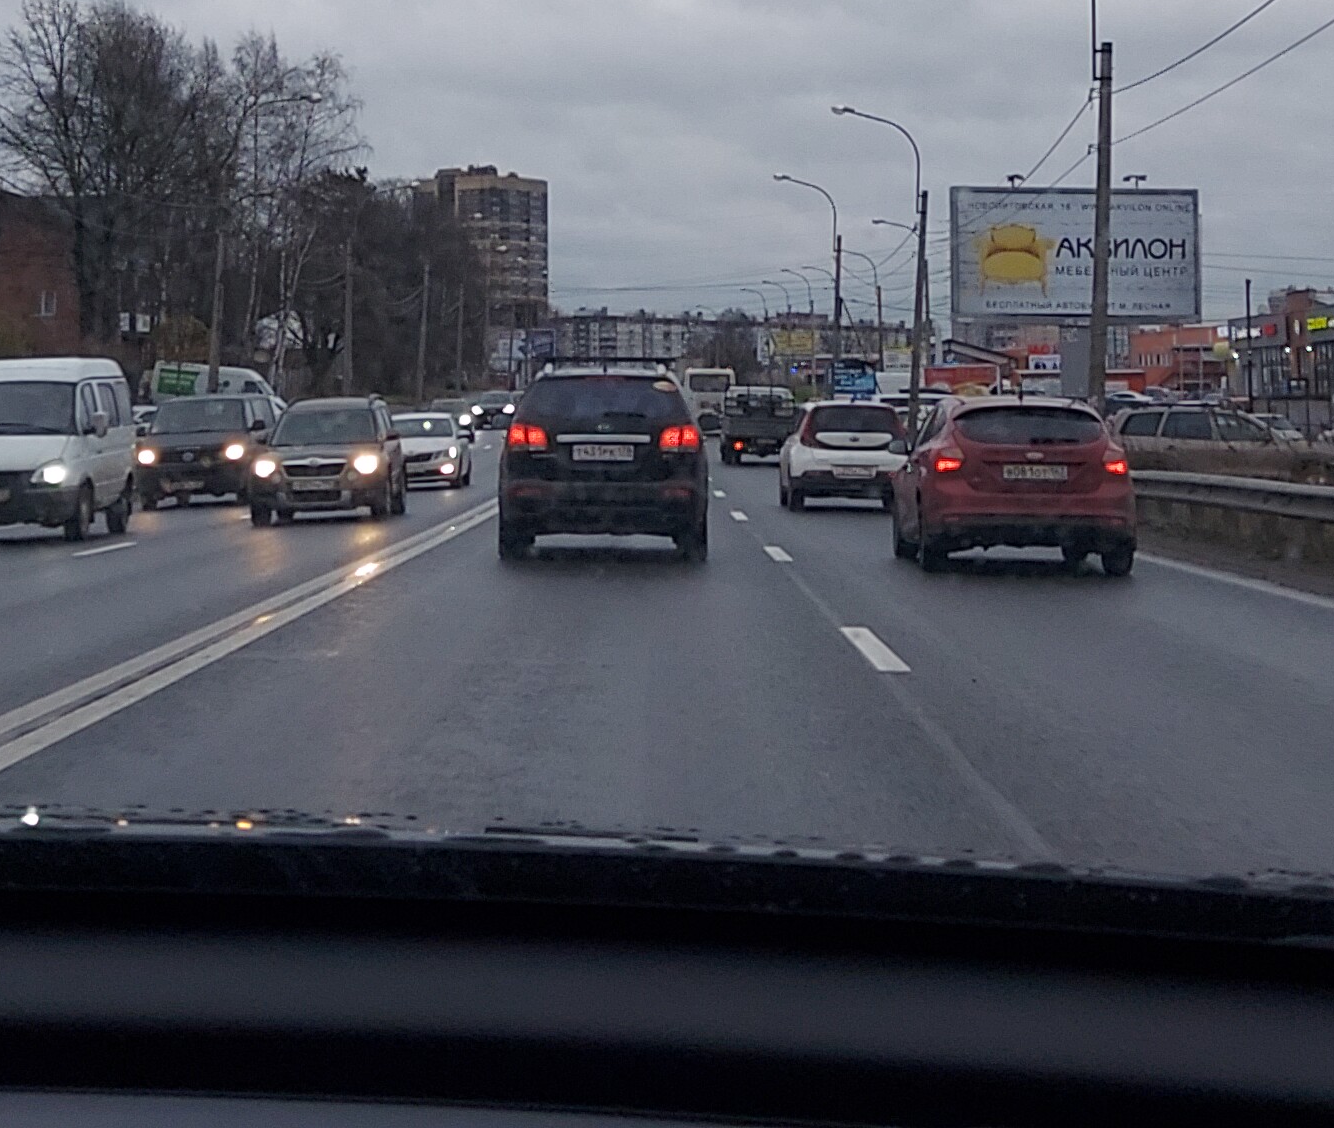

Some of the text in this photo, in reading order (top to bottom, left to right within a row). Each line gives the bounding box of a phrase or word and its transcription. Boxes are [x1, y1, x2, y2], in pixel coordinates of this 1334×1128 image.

[1055, 237, 1186, 260] АКИЛОН
[1055, 264, 1189, 279] МЕБЕНЫЙ ЦЕНТР
